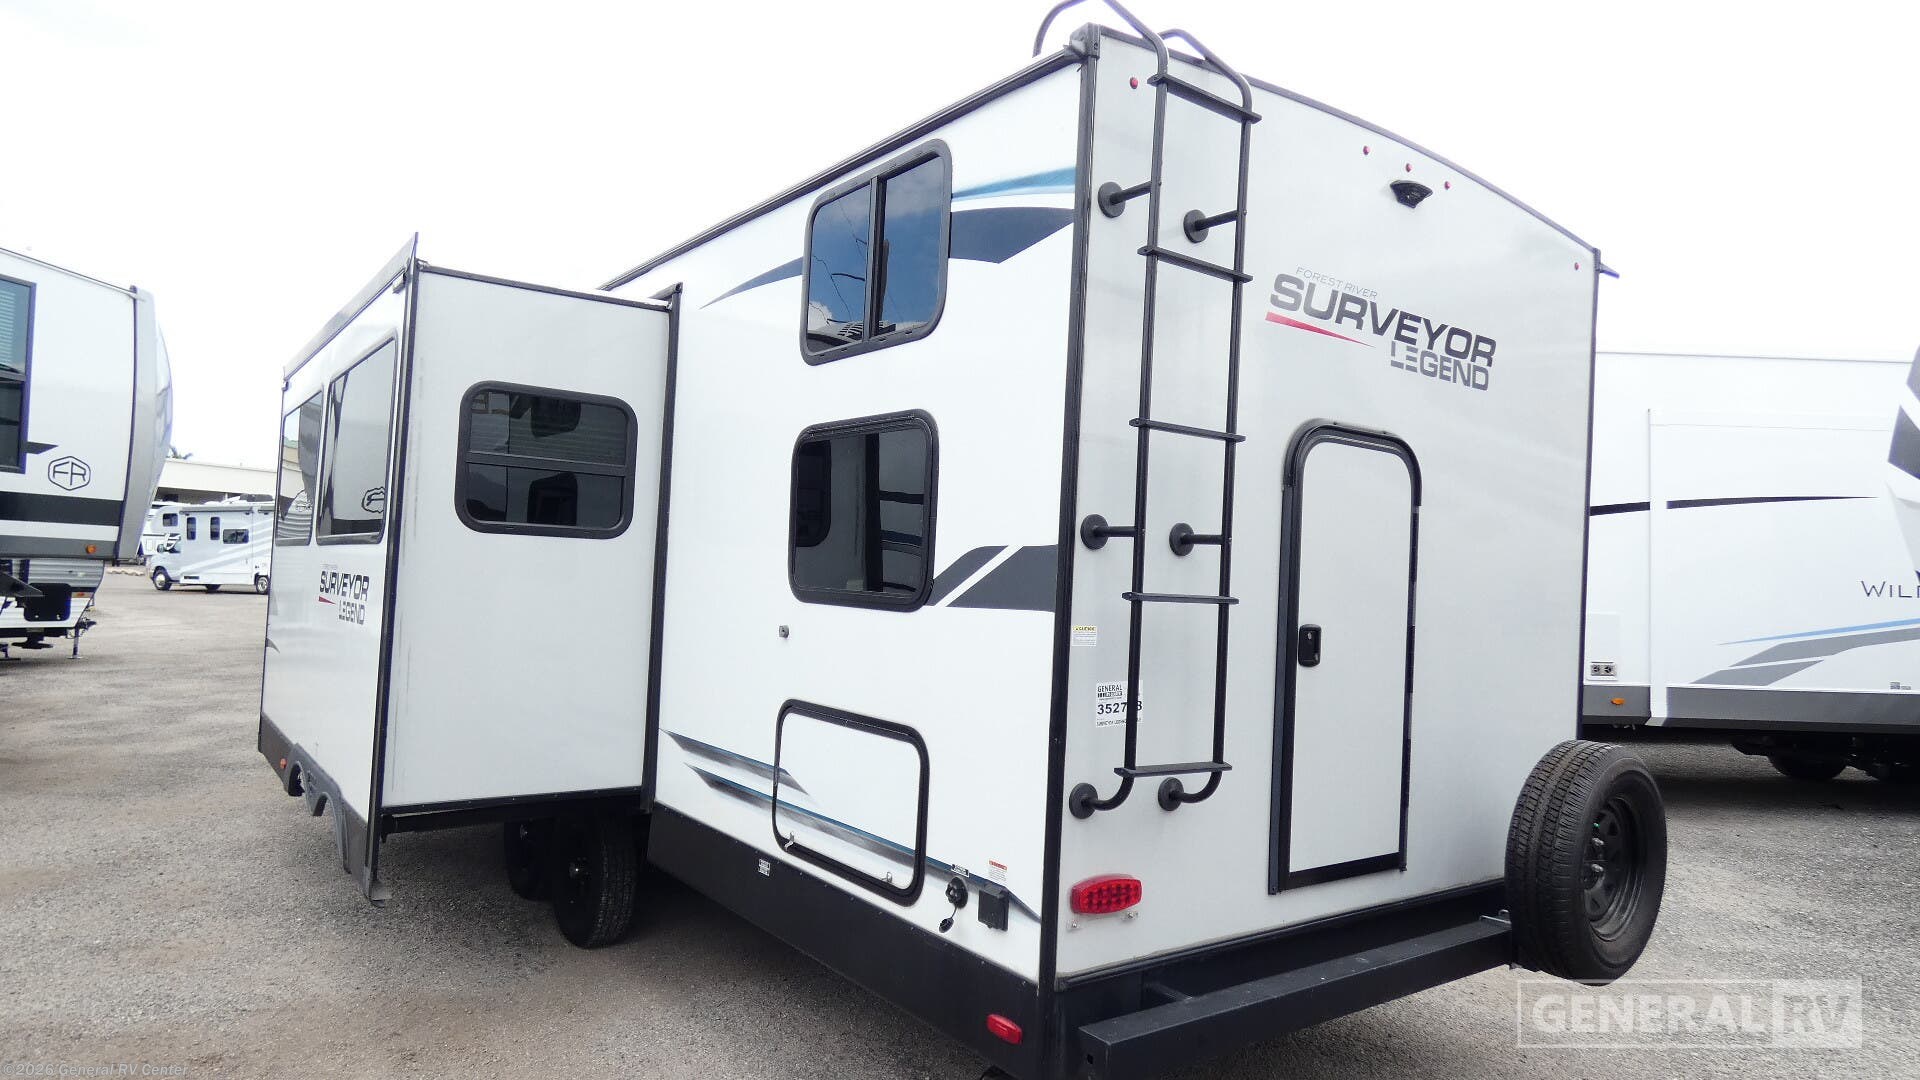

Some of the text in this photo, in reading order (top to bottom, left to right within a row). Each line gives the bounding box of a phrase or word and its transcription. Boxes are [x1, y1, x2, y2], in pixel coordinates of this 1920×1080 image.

[1296, 266, 1378, 301] FOREST RIVER
[1270, 273, 1497, 367] SURVEYOR
[1390, 340, 1489, 391] LEGEND
[320, 571, 370, 601] SURVEYOR
[1861, 580, 1920, 598] WIL
[339, 600, 365, 624] LEGEND
[1097, 684, 1122, 692] GENERAL
